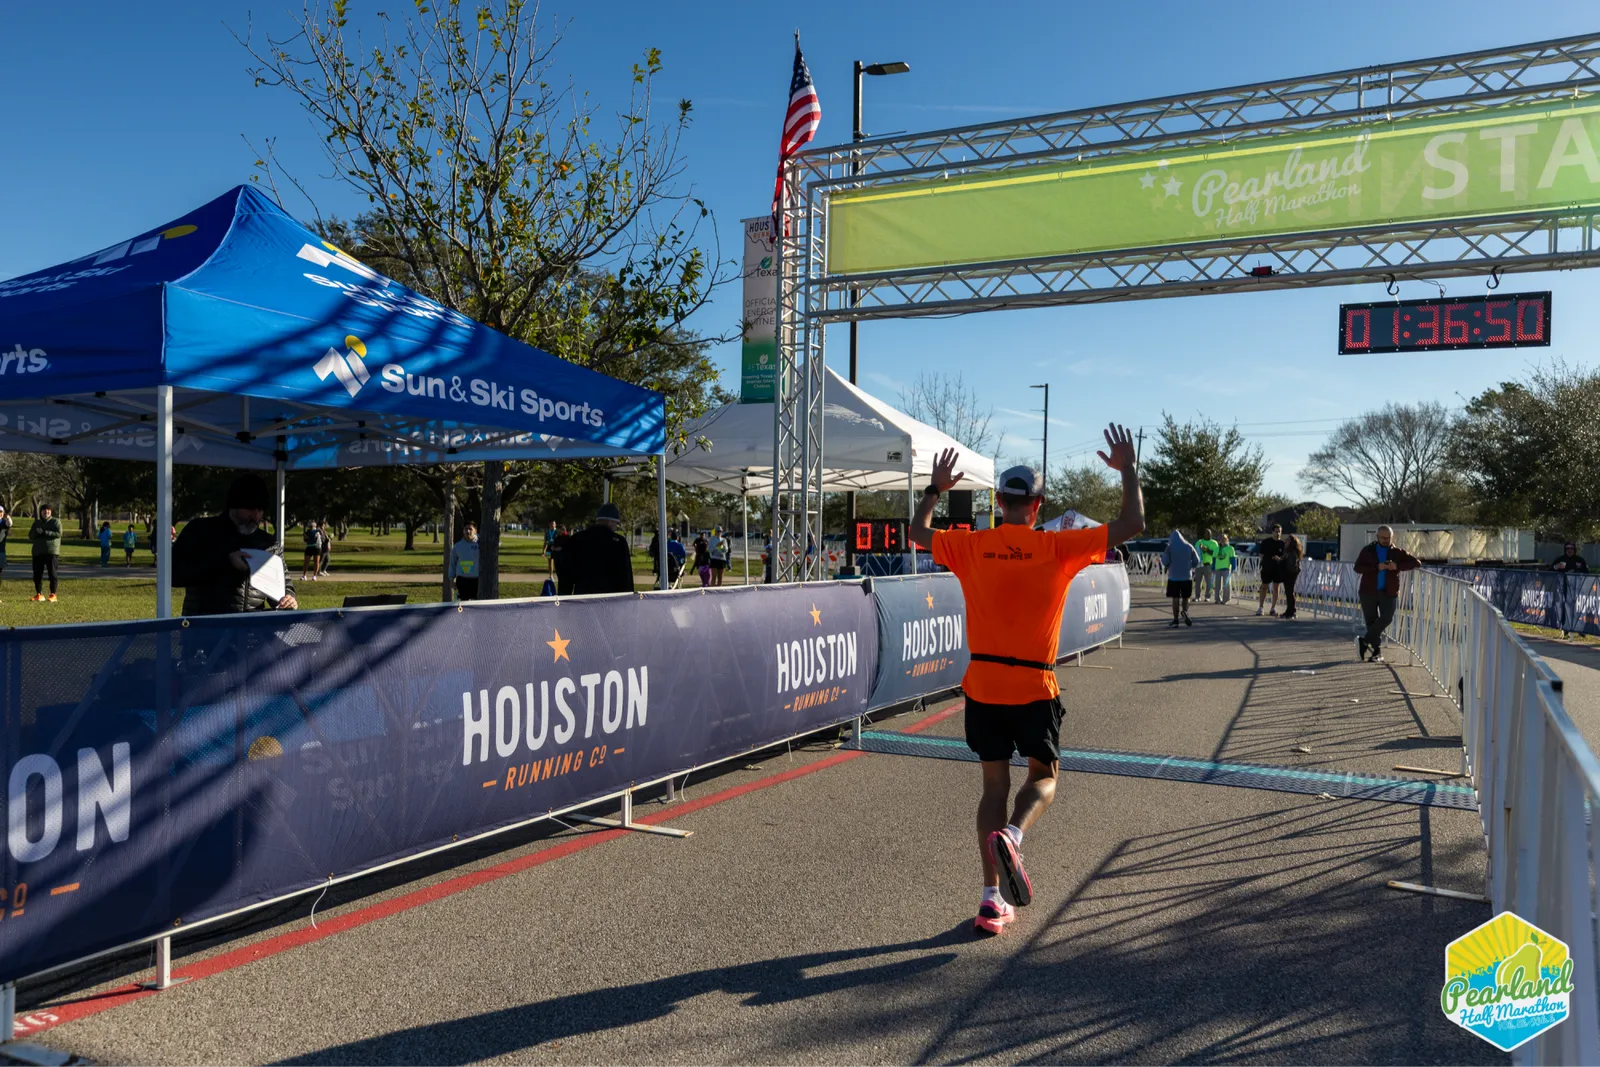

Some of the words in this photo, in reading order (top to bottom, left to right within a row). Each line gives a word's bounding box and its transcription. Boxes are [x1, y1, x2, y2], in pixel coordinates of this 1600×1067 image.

[1192, 128, 1371, 217] Pearland
[1215, 203, 1261, 229] Half
[1264, 181, 1361, 217] Marathon
[745, 297, 776, 308] OFFICIA
[1345, 299, 1545, 349] 01:36:50
[520, 389, 604, 428] Sports
[902, 614, 962, 661] HOUSTON
[776, 631, 857, 694] HOUSTON
[462, 666, 648, 765] HOUSTON
[793, 688, 829, 712] RUNNING
[504, 750, 584, 791] RUNNING
